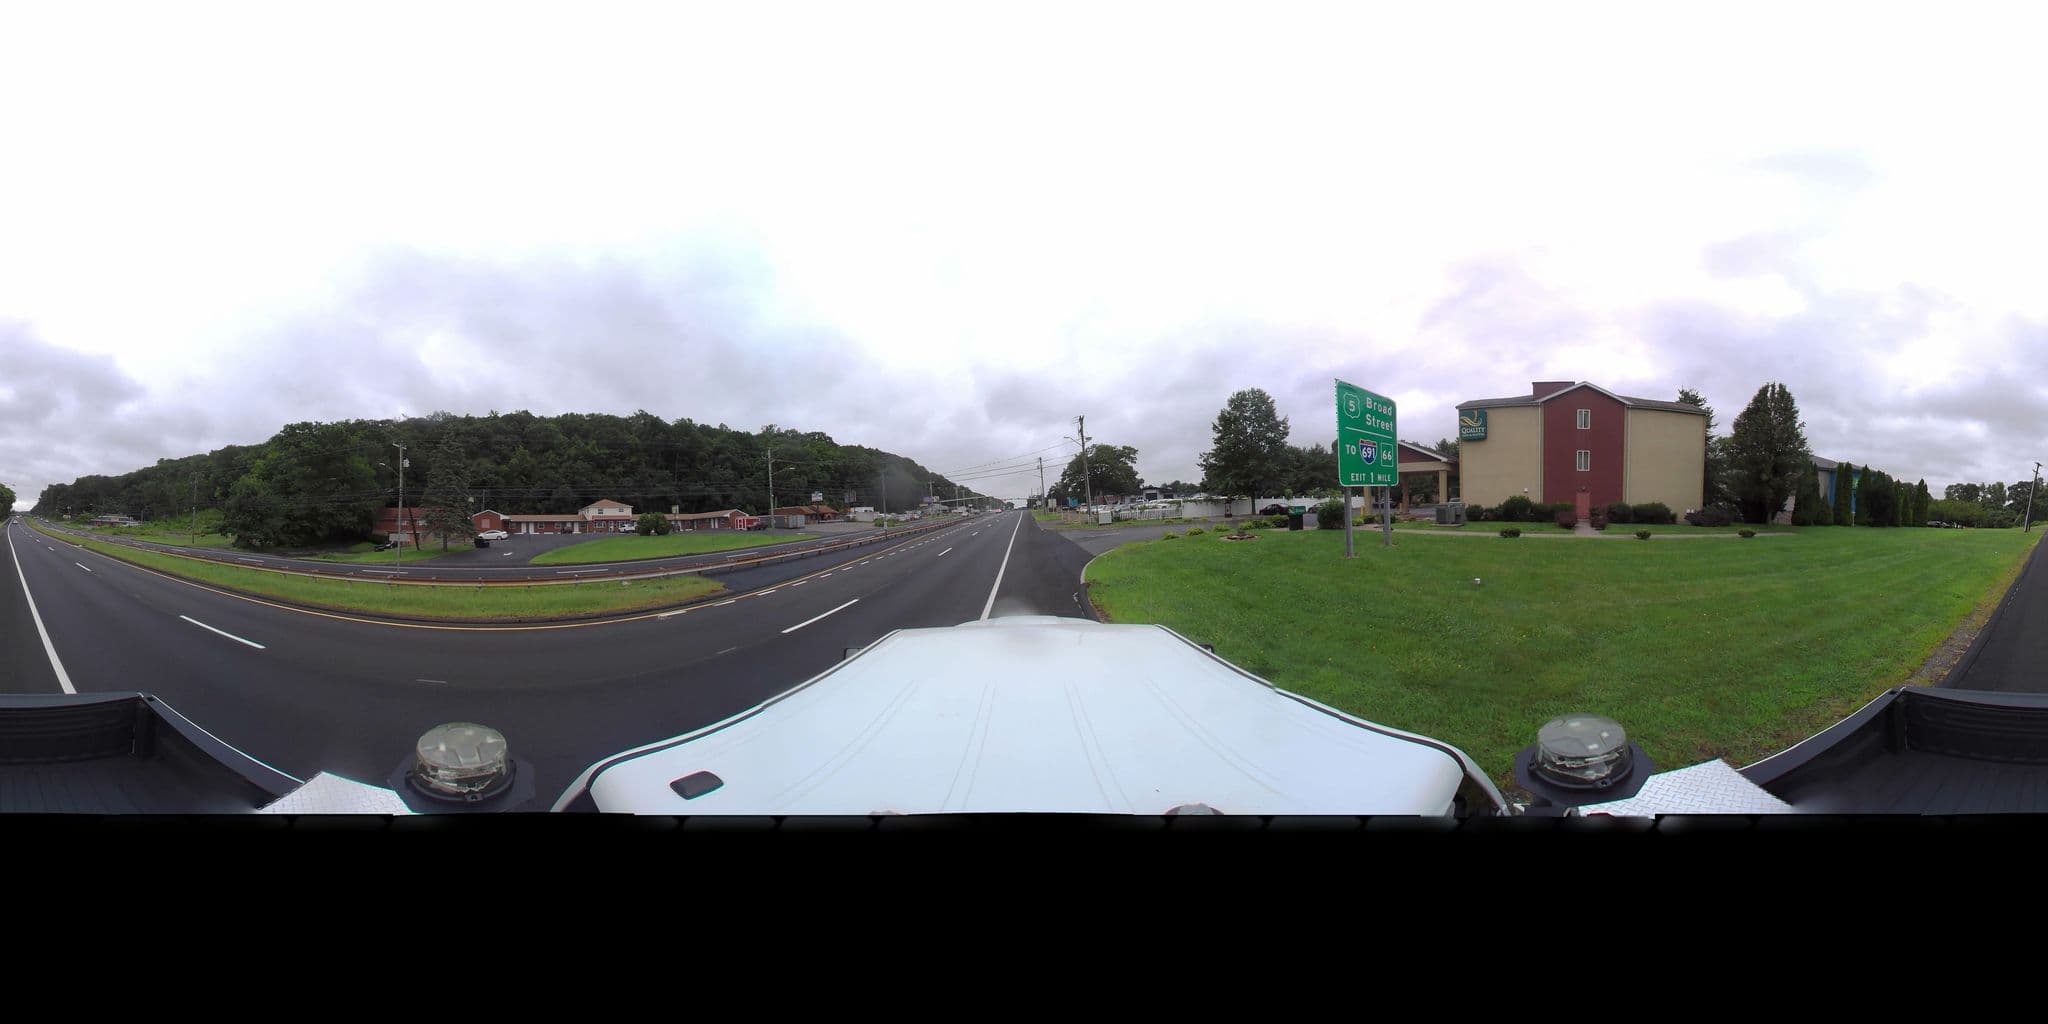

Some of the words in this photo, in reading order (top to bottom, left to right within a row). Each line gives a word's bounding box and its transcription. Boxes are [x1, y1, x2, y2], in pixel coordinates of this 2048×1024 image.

[1348, 400, 1356, 412] 5
[1366, 397, 1392, 416] Broad
[1366, 414, 1393, 432] Street
[1345, 444, 1356, 455] TO
[1362, 446, 1376, 458] 691
[1382, 450, 1392, 461] 66
[1350, 472, 1366, 482] EXIT
[1370, 472, 1374, 483] 1
[1377, 474, 1391, 482] MILE
